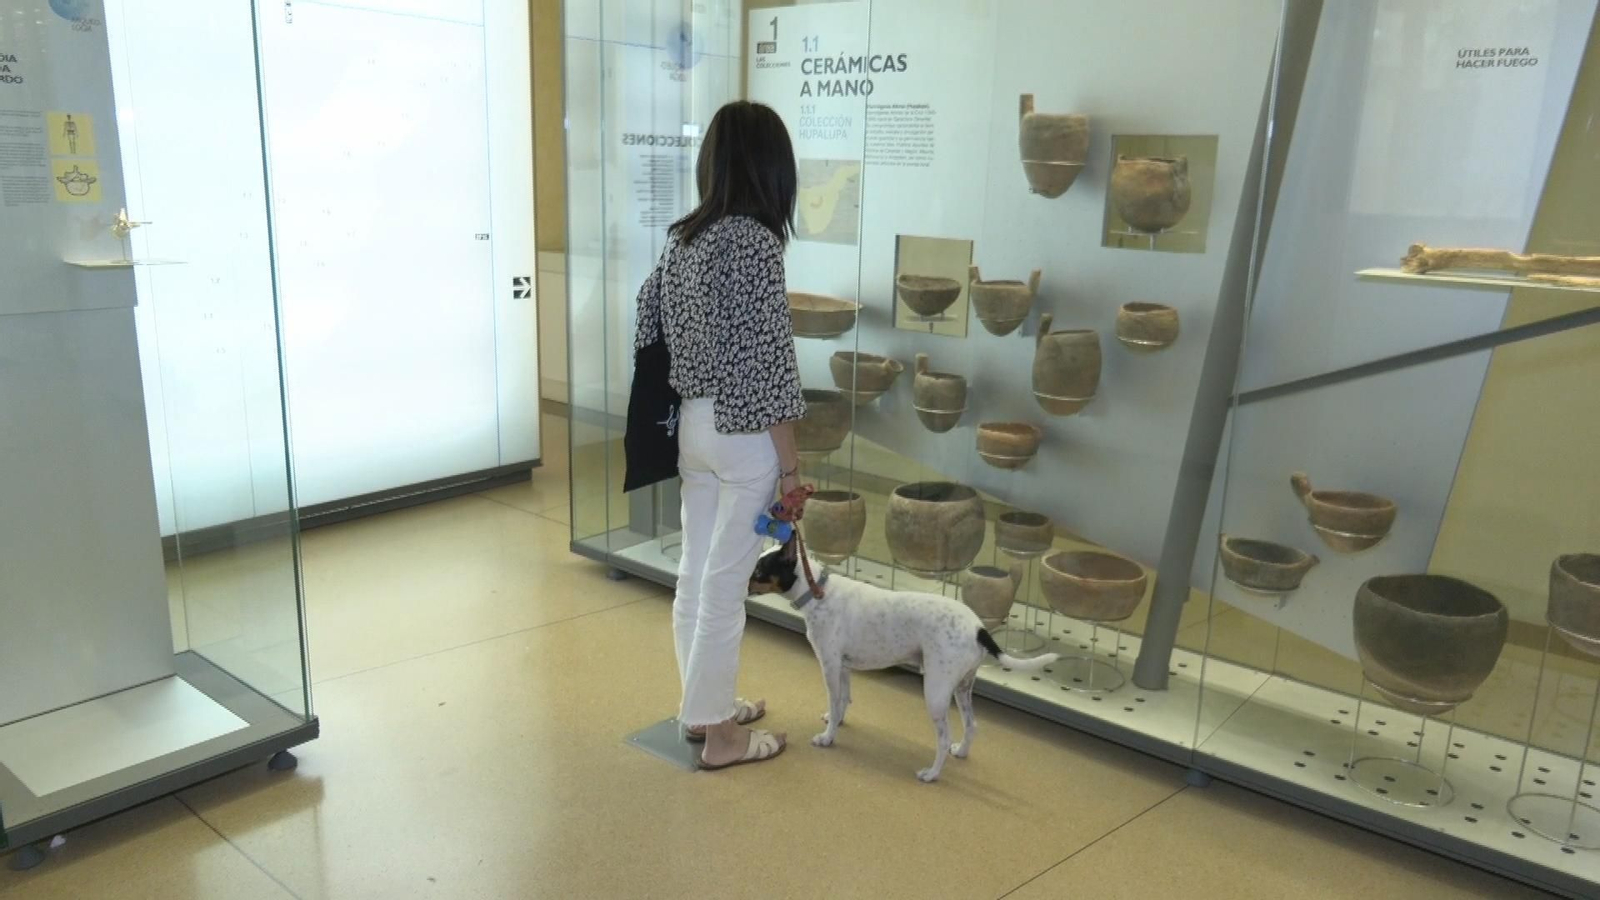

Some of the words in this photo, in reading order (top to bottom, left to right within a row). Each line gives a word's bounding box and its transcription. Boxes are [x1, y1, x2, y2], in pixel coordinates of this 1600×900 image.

[770, 16, 778, 41] 1
[802, 36, 819, 52] 1.1
[1457, 47, 1496, 58] ÚTILES
[1498, 47, 1530, 57] PARA
[801, 52, 908, 75] CERÁMICAS
[1456, 59, 1495, 68] HACER
[1496, 58, 1539, 68] FUEGO
[800, 80, 812, 97] A
[817, 79, 874, 97] MANO
[800, 105, 816, 115] 1.1.1
[799, 114, 853, 127] COLECCIÓN
[799, 128, 848, 140] HUPALUPA
